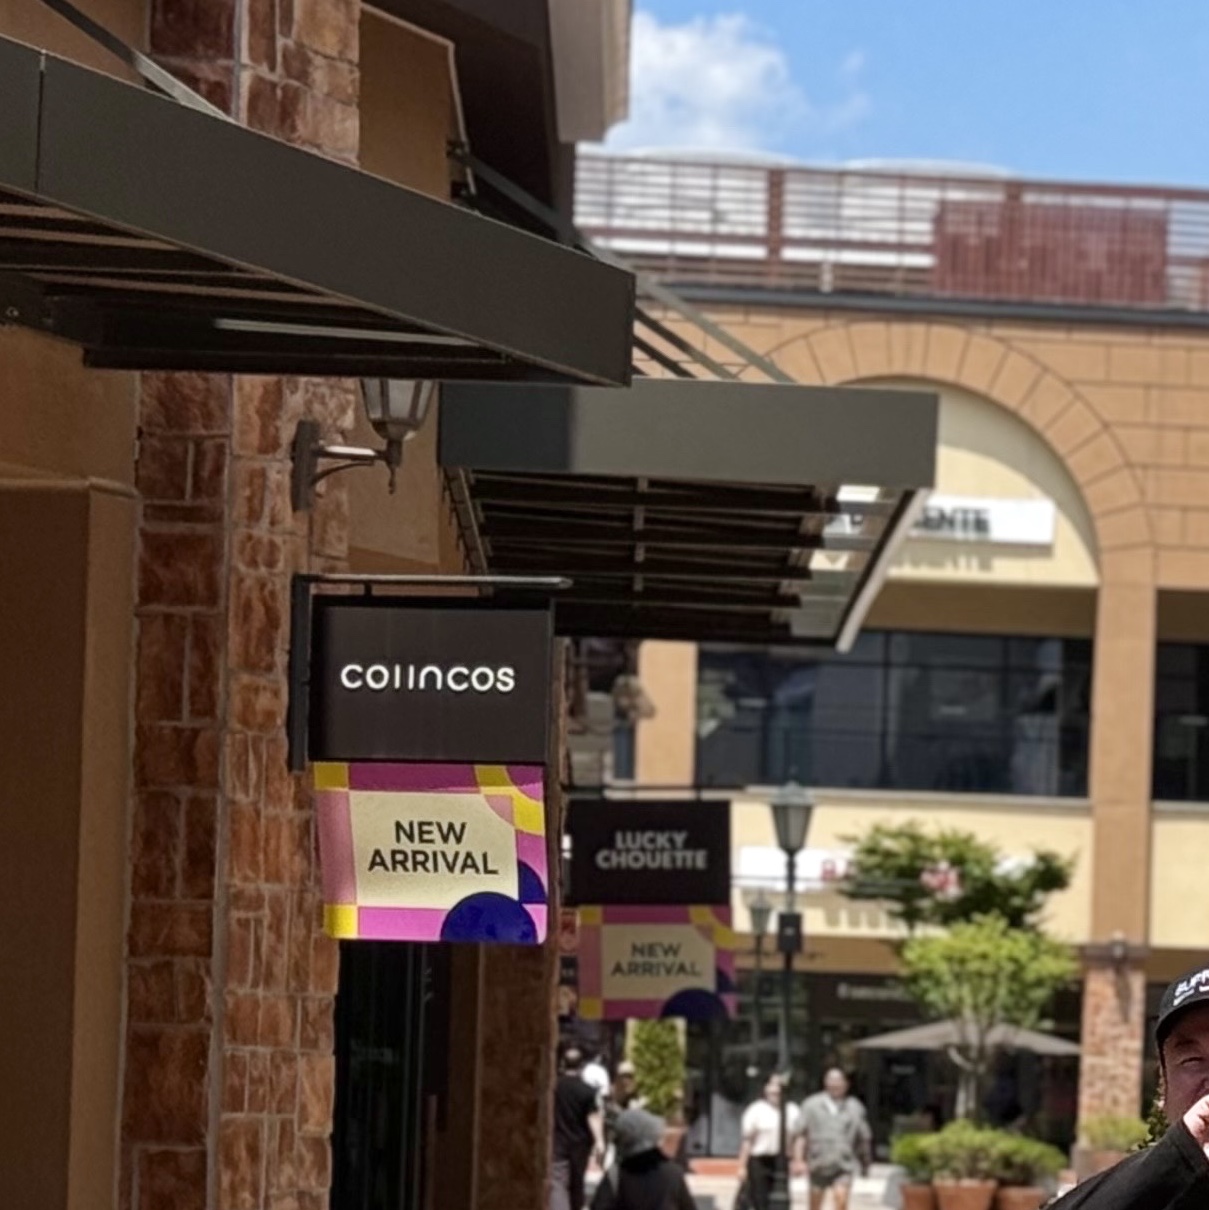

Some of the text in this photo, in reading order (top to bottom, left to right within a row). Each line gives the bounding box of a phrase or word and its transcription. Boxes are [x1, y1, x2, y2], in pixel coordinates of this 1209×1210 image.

[394, 819, 467, 845] NEW
[615, 831, 688, 850] LUCKY
[367, 847, 499, 875] ARRIVAL
[595, 849, 709, 870] CHOUETTE
[631, 942, 682, 959] NEW
[611, 961, 702, 977] ARRIVAL
